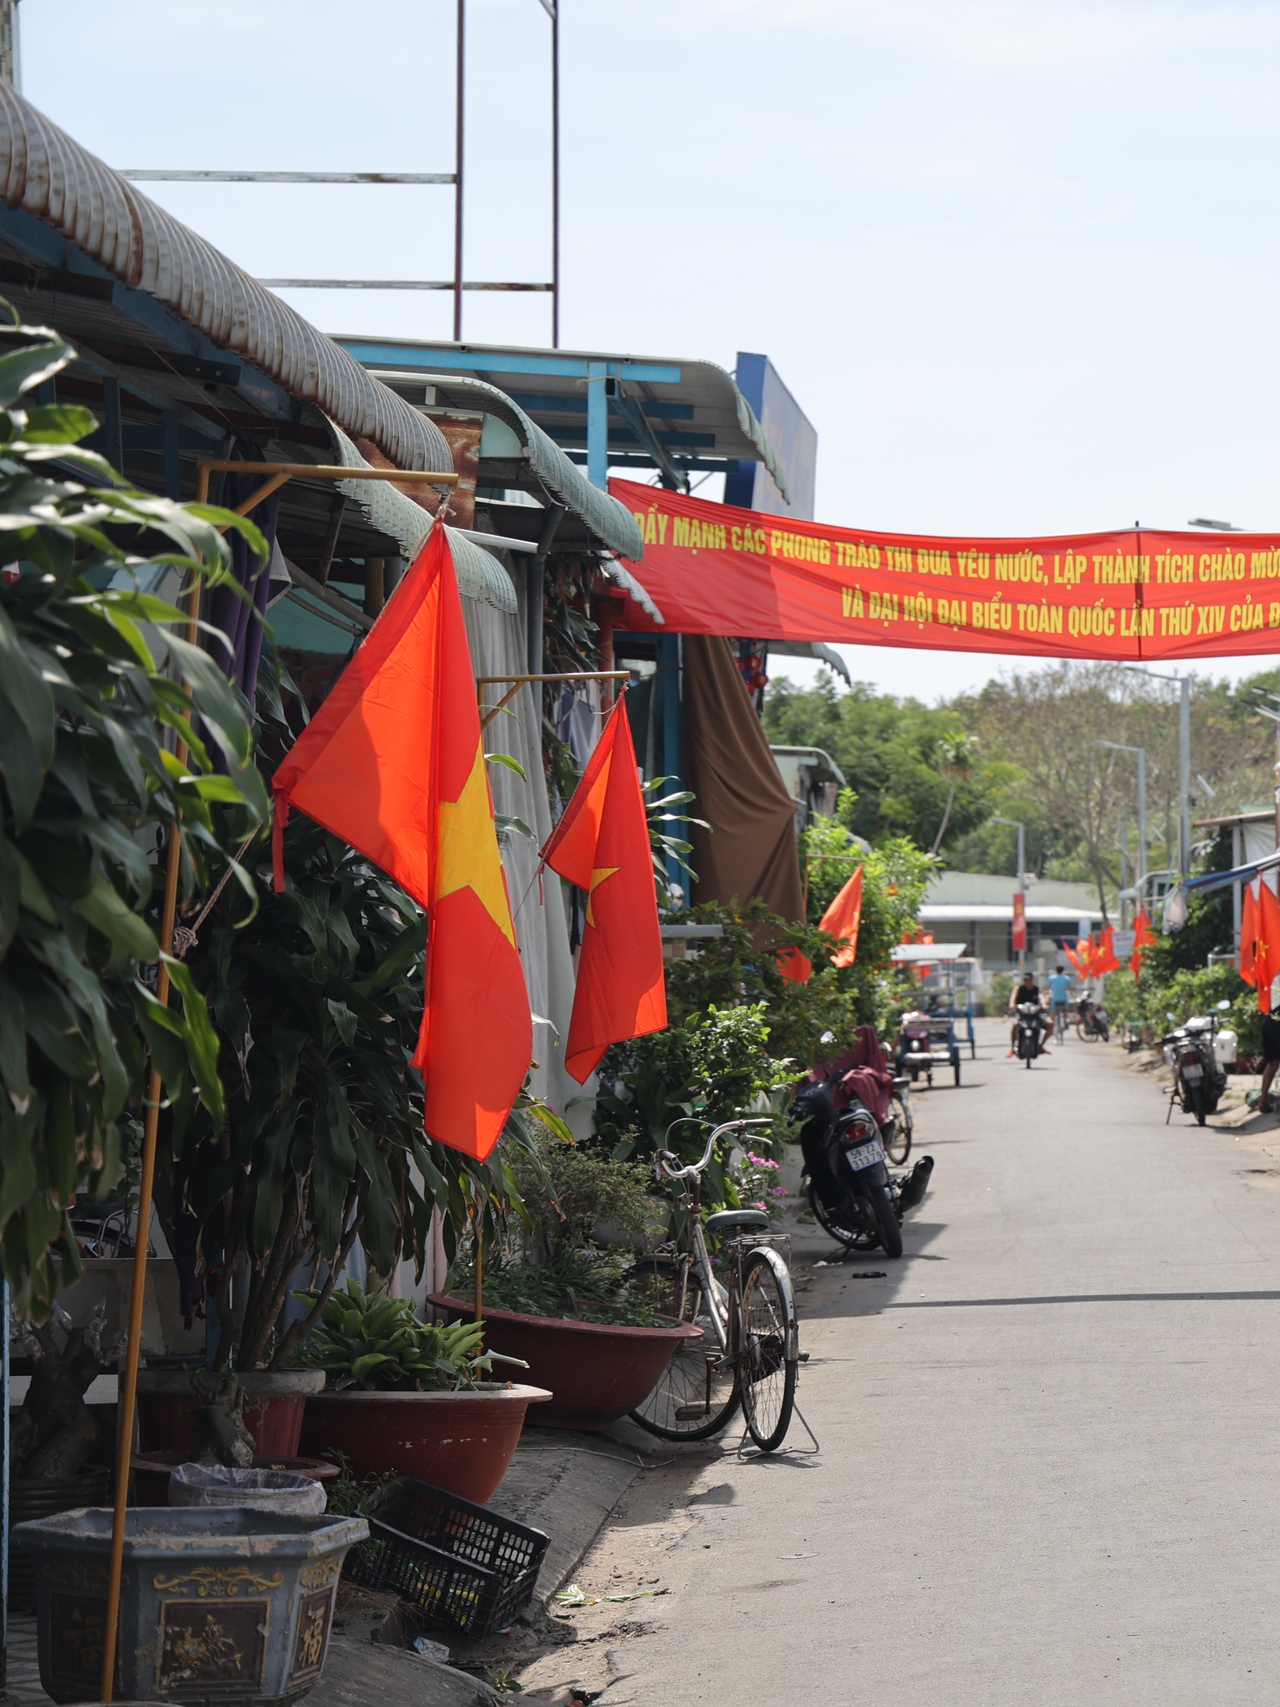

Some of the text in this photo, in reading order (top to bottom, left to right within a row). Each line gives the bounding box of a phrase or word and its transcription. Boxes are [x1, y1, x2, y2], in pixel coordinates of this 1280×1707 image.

[673, 517, 727, 555] MẠNH
[731, 523, 767, 555] CÁC
[770, 530, 831, 566] PHONG
[834, 540, 882, 569] TRÀO
[884, 546, 912, 573] THI
[916, 548, 952, 576] ĐUA
[957, 548, 990, 579] YÊU
[995, 548, 1049, 586] NƯỚC,
[1053, 548, 1087, 590] LẬP
[1092, 549, 1150, 584] THÀNH
[1155, 548, 1194, 583] TÍCH
[1199, 547, 1246, 582] CHÀO
[841, 584, 864, 618] VÀ
[869, 591, 898, 627] ĐẠI
[903, 591, 933, 629] HỘI
[937, 598, 967, 631] ĐẠI
[972, 591, 1012, 631] BIỂU
[1016, 598, 1063, 634] TOÀN
[1068, 598, 1115, 638] QUỐC
[1120, 598, 1155, 637] LẦN
[1159, 600, 1195, 636] THỨ
[1196, 605, 1226, 635] XIV
[1230, 594, 1264, 632] CỦA
